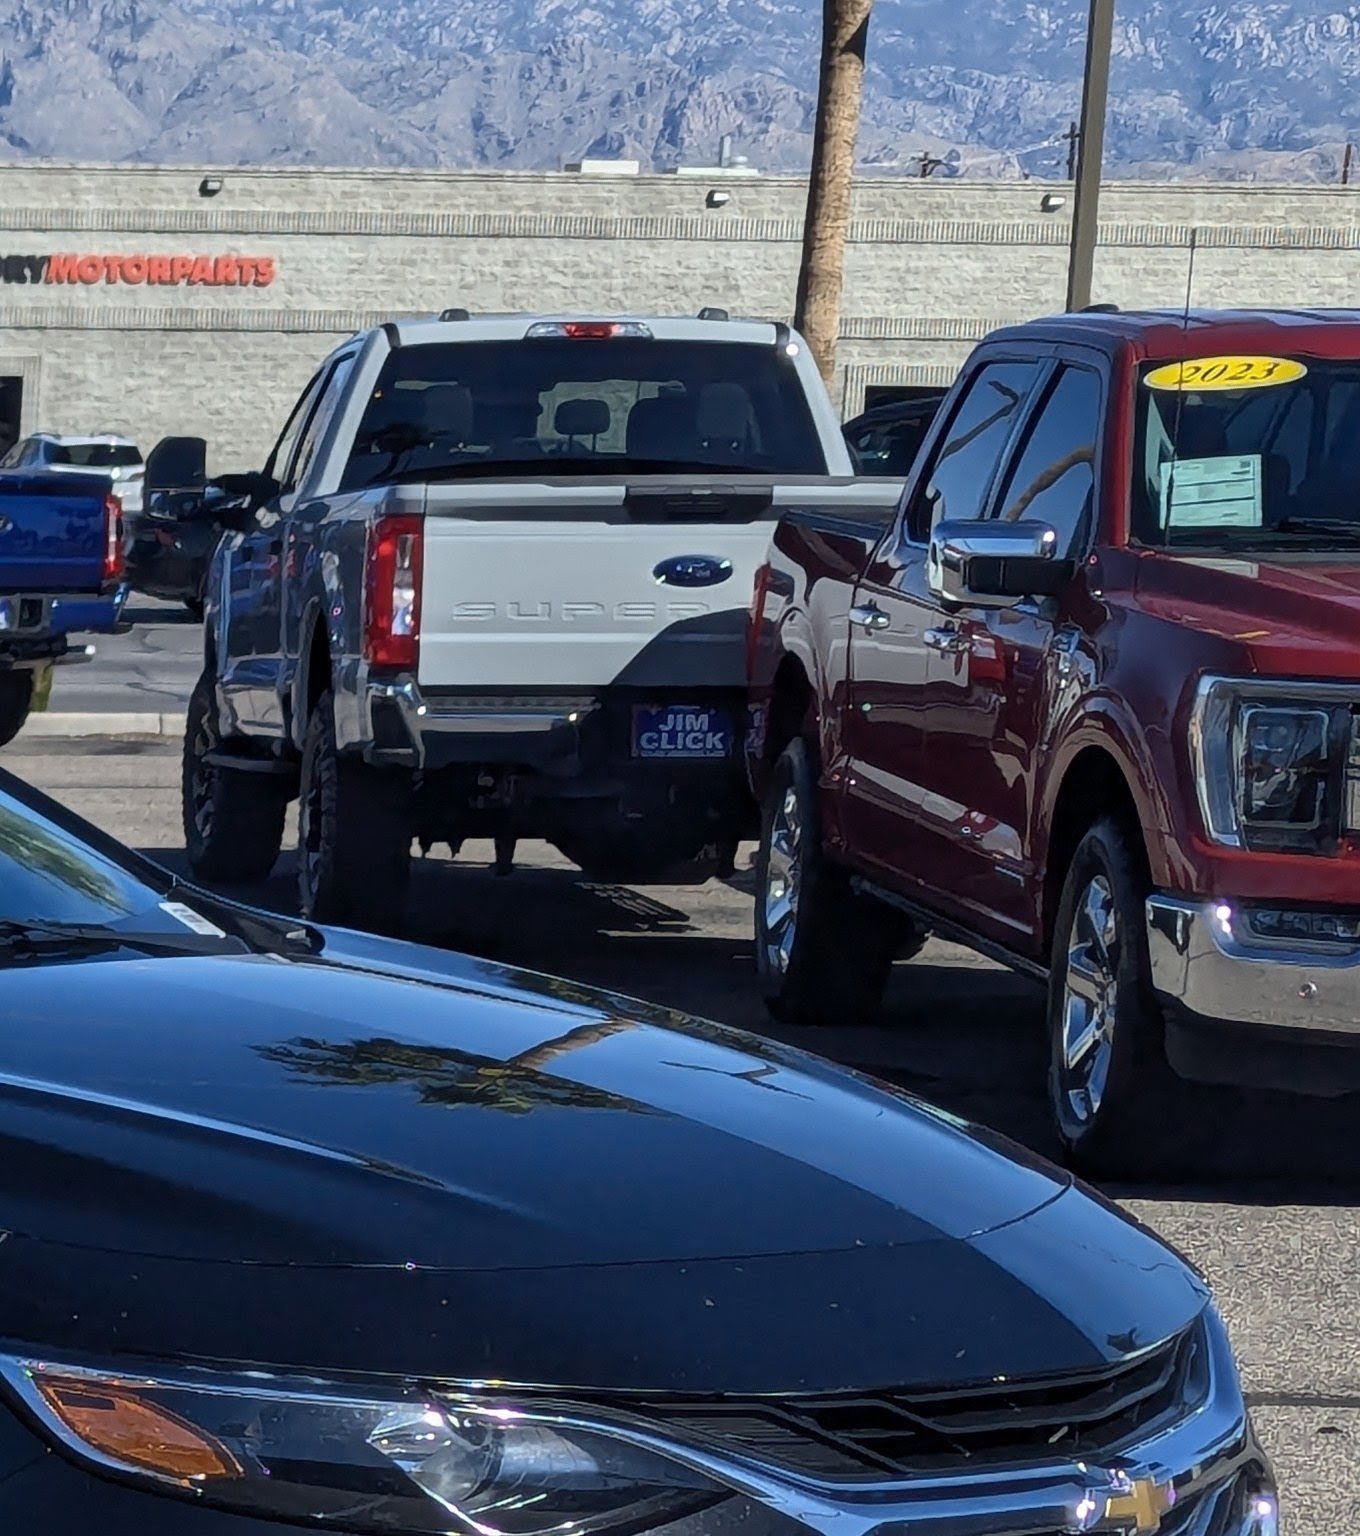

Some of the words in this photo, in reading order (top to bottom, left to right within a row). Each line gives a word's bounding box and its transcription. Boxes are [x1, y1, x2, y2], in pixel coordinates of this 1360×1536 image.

[1173, 362, 1280, 385] 2023
[658, 712, 709, 732] JIM
[640, 731, 724, 750] CLICK
